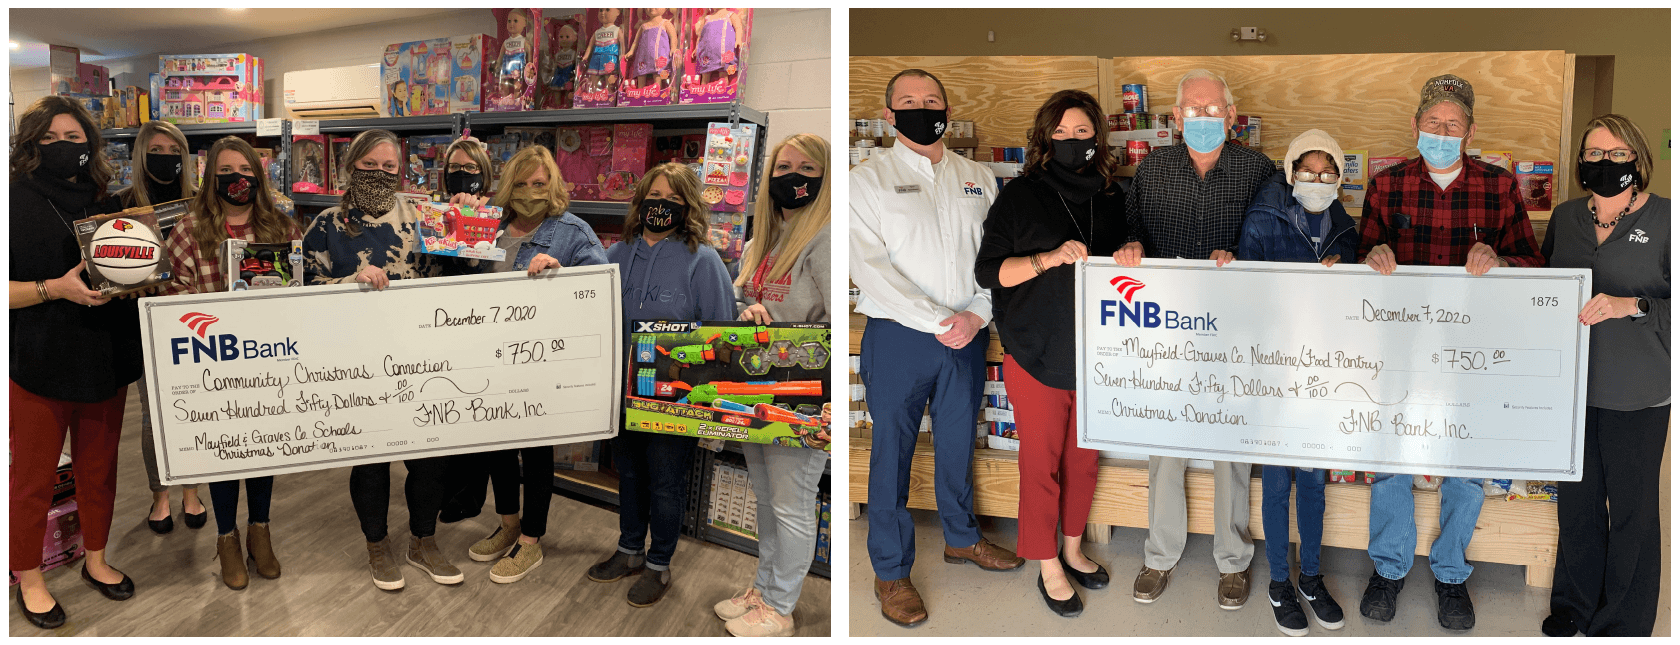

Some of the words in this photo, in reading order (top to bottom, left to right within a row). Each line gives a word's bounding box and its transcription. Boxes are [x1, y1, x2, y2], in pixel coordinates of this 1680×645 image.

[628, 89, 643, 97] my
[643, 86, 659, 95] life
[691, 86, 706, 94] my
[708, 84, 725, 93] life
[964, 187, 982, 195] FNB
[646, 211, 672, 227] kind
[1628, 233, 1650, 244] FNB
[93, 244, 155, 259] LOUISVILLE
[573, 289, 596, 300] 1875
[1530, 296, 1559, 307] 1875
[434, 307, 486, 328] December
[504, 305, 537, 322] 2020
[1100, 299, 1161, 328] FNB
[1165, 310, 1218, 332] Bank
[1362, 298, 1421, 323] December
[1436, 308, 1471, 325] 2020
[171, 333, 239, 365] FNB
[242, 337, 299, 360] Bank
[495, 348, 502, 359] $
[1230, 345, 1246, 363] Co.
[1334, 350, 1385, 380] Pantry
[1431, 352, 1440, 364] $
[202, 368, 290, 398] Community
[294, 362, 374, 384] Christmas
[383, 354, 453, 377] Connection
[1093, 362, 1127, 389] Seven
[1128, 367, 1183, 392] Hundred
[1188, 371, 1229, 403] Fifty
[1230, 375, 1284, 398] Dollars
[660, 384, 673, 392] 24
[173, 399, 220, 422] Seven
[220, 399, 291, 420] Hundred
[295, 390, 332, 417] Fifty
[332, 392, 377, 410] Dollars
[413, 399, 460, 427] FNB
[465, 398, 521, 422] Bank,
[524, 401, 547, 417] Inc.
[665, 405, 714, 421] ATTACK
[1112, 397, 1178, 422] Christmas
[1180, 403, 1248, 426] Donation
[715, 425, 741, 433] REPEL
[1339, 409, 1382, 434] FNB
[1444, 418, 1473, 440] Inc.
[194, 432, 241, 456] Mayfield
[251, 429, 291, 444] Graves
[294, 425, 308, 440] Co.
[312, 421, 362, 438] Schools
[697, 429, 749, 440] ELIMINATOR
[217, 446, 275, 460] Christmas
